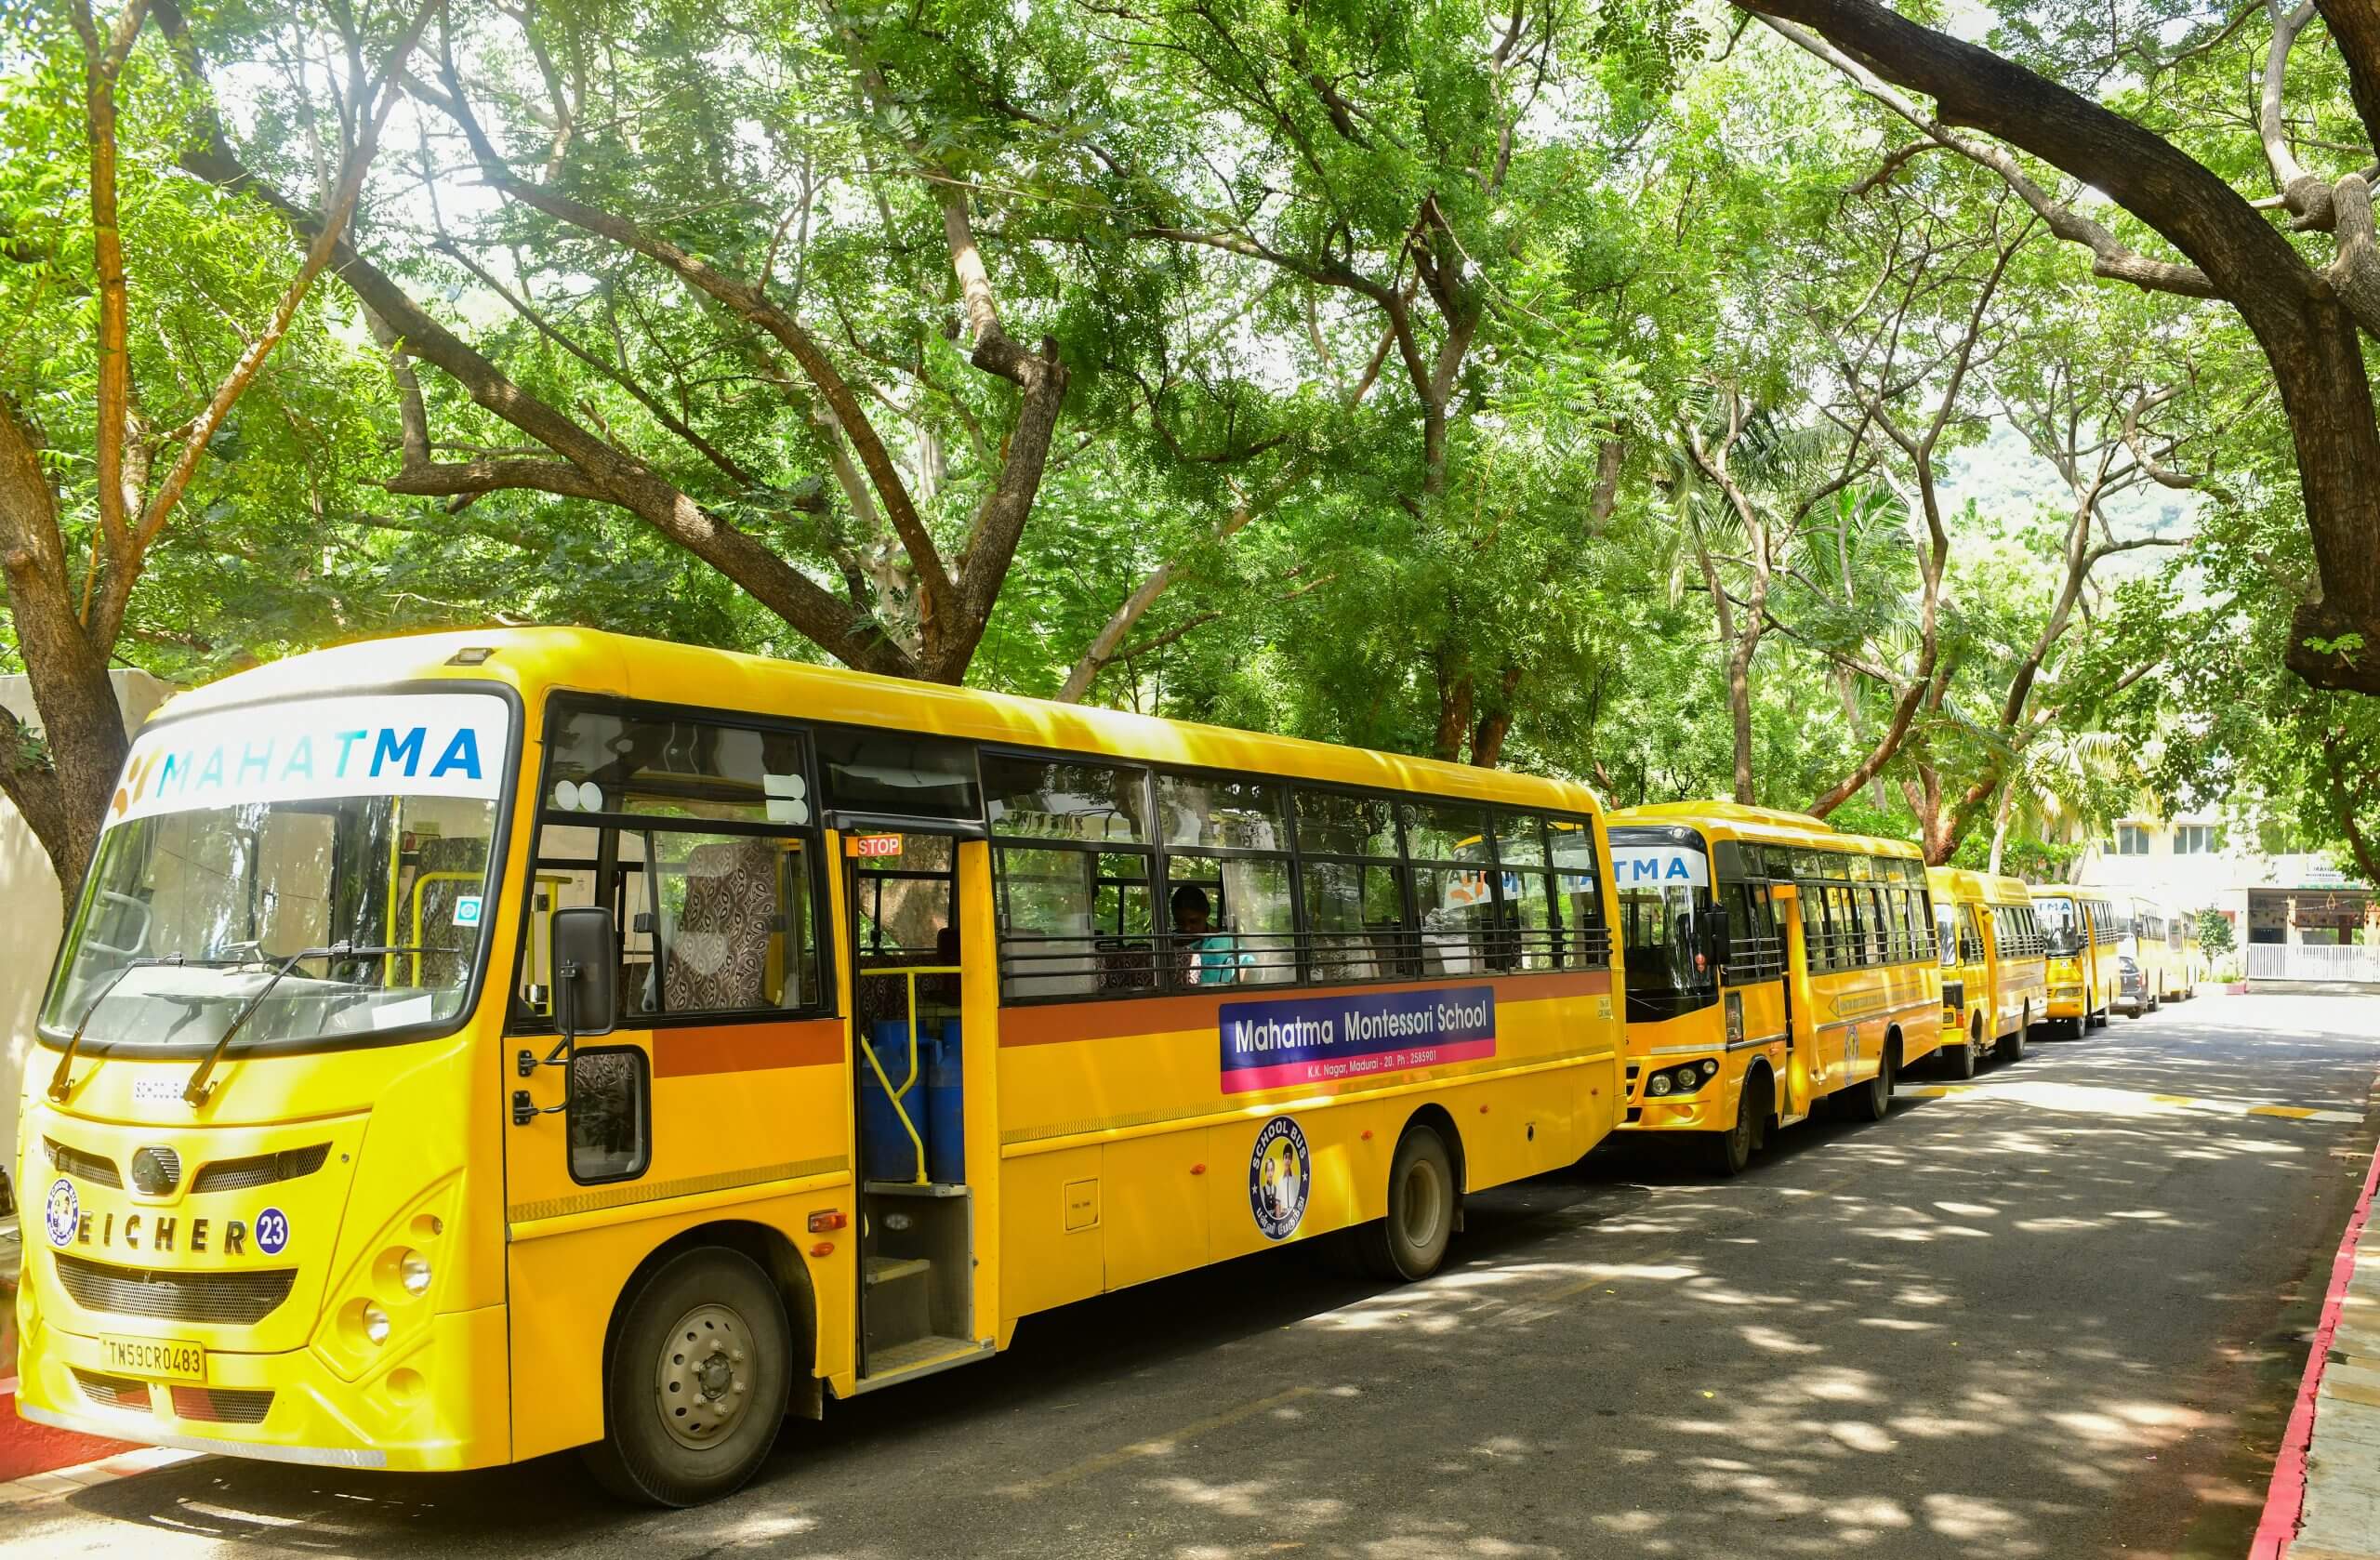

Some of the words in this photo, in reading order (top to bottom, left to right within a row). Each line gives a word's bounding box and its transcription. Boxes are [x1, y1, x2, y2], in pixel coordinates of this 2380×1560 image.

[156, 728, 483, 799] MAHATMA
[858, 839, 899, 854] STOP
[1235, 1015, 1334, 1053] Mahatma
[1344, 1004, 1434, 1042] Montessori
[1437, 999, 1487, 1032] School
[1308, 1064, 1322, 1078] K.K.
[1323, 1063, 1348, 1077] Nagar,
[1349, 1058, 1379, 1073] Madurai
[1410, 1050, 1436, 1064] 2585901
[1252, 1120, 1289, 1170] SCHOOL
[1289, 1125, 1307, 1160] BUS
[78, 1210, 248, 1255] EICHER
[260, 1215, 284, 1245] 23
[109, 1342, 201, 1373] TN59CR0483
